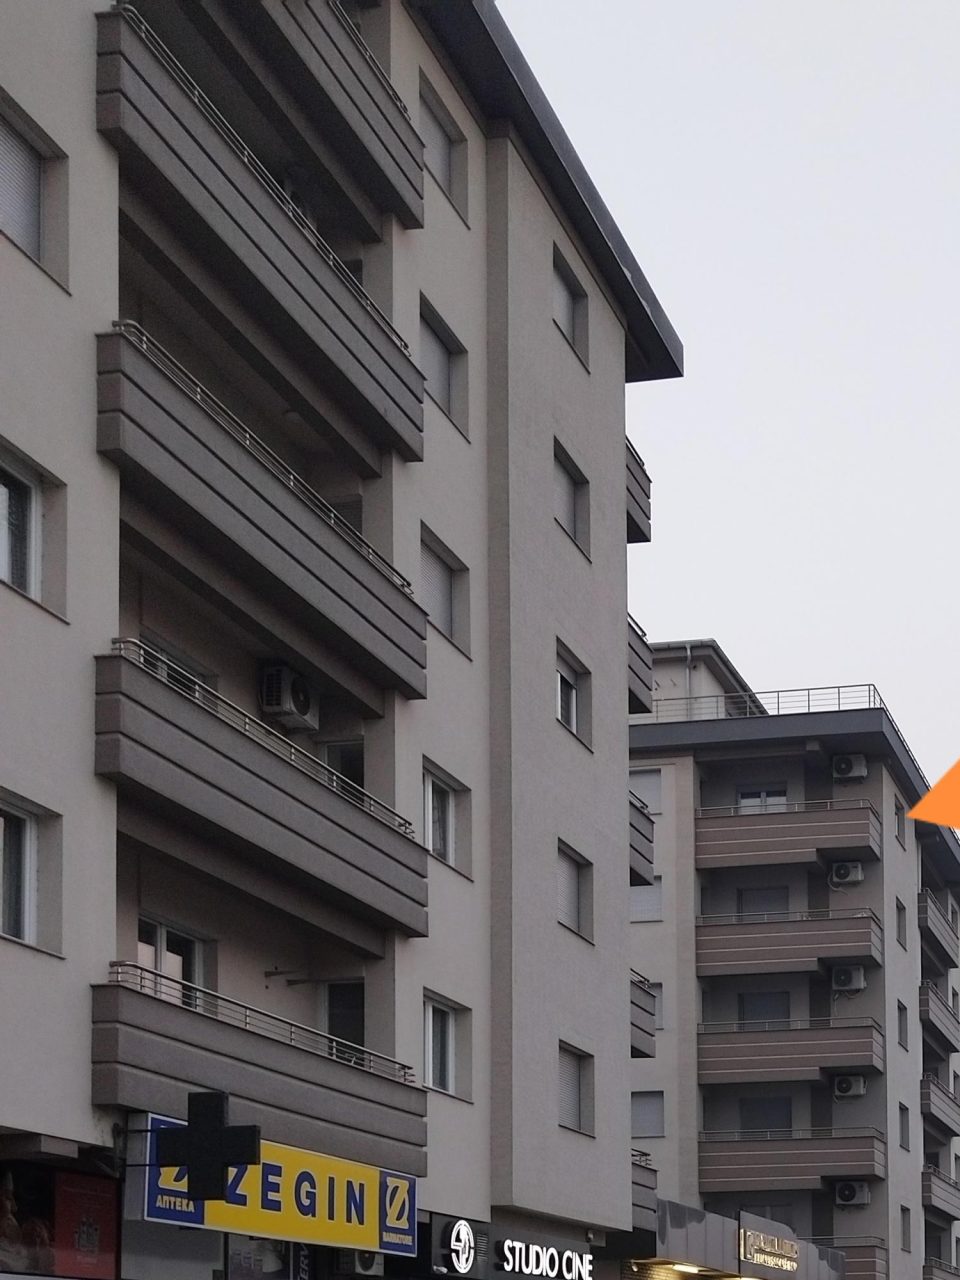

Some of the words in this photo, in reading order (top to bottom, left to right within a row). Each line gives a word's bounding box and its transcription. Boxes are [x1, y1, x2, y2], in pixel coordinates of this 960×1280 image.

[156, 1194, 195, 1214] АПТЕКА
[226, 1161, 365, 1226] ZEGIN
[503, 1239, 559, 1278] STUDIO
